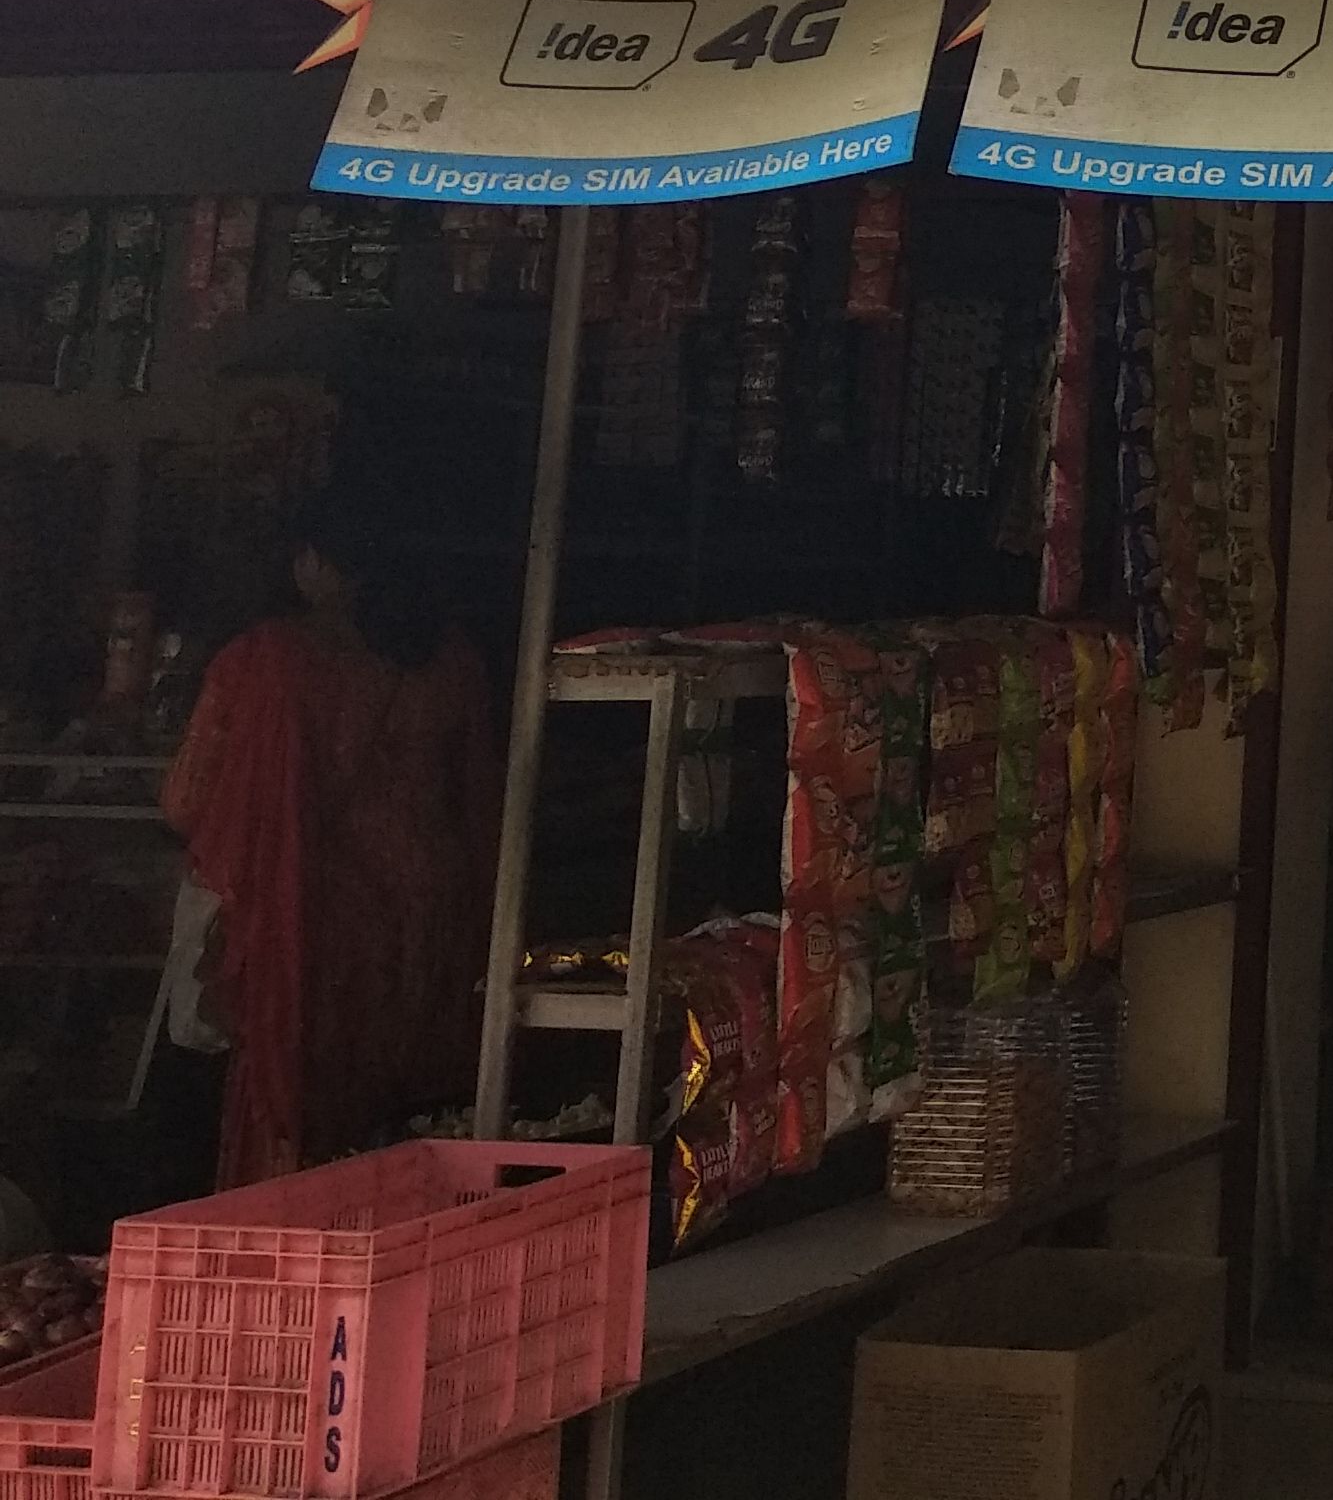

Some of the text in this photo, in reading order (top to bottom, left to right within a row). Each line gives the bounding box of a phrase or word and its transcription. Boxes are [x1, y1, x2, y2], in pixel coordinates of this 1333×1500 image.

[338, 131, 893, 196] 4G Upgrade SIM Available Here
[977, 142, 1037, 171] 4G
[1051, 147, 1226, 187] Upgrade
[1240, 160, 1313, 188] SIM
